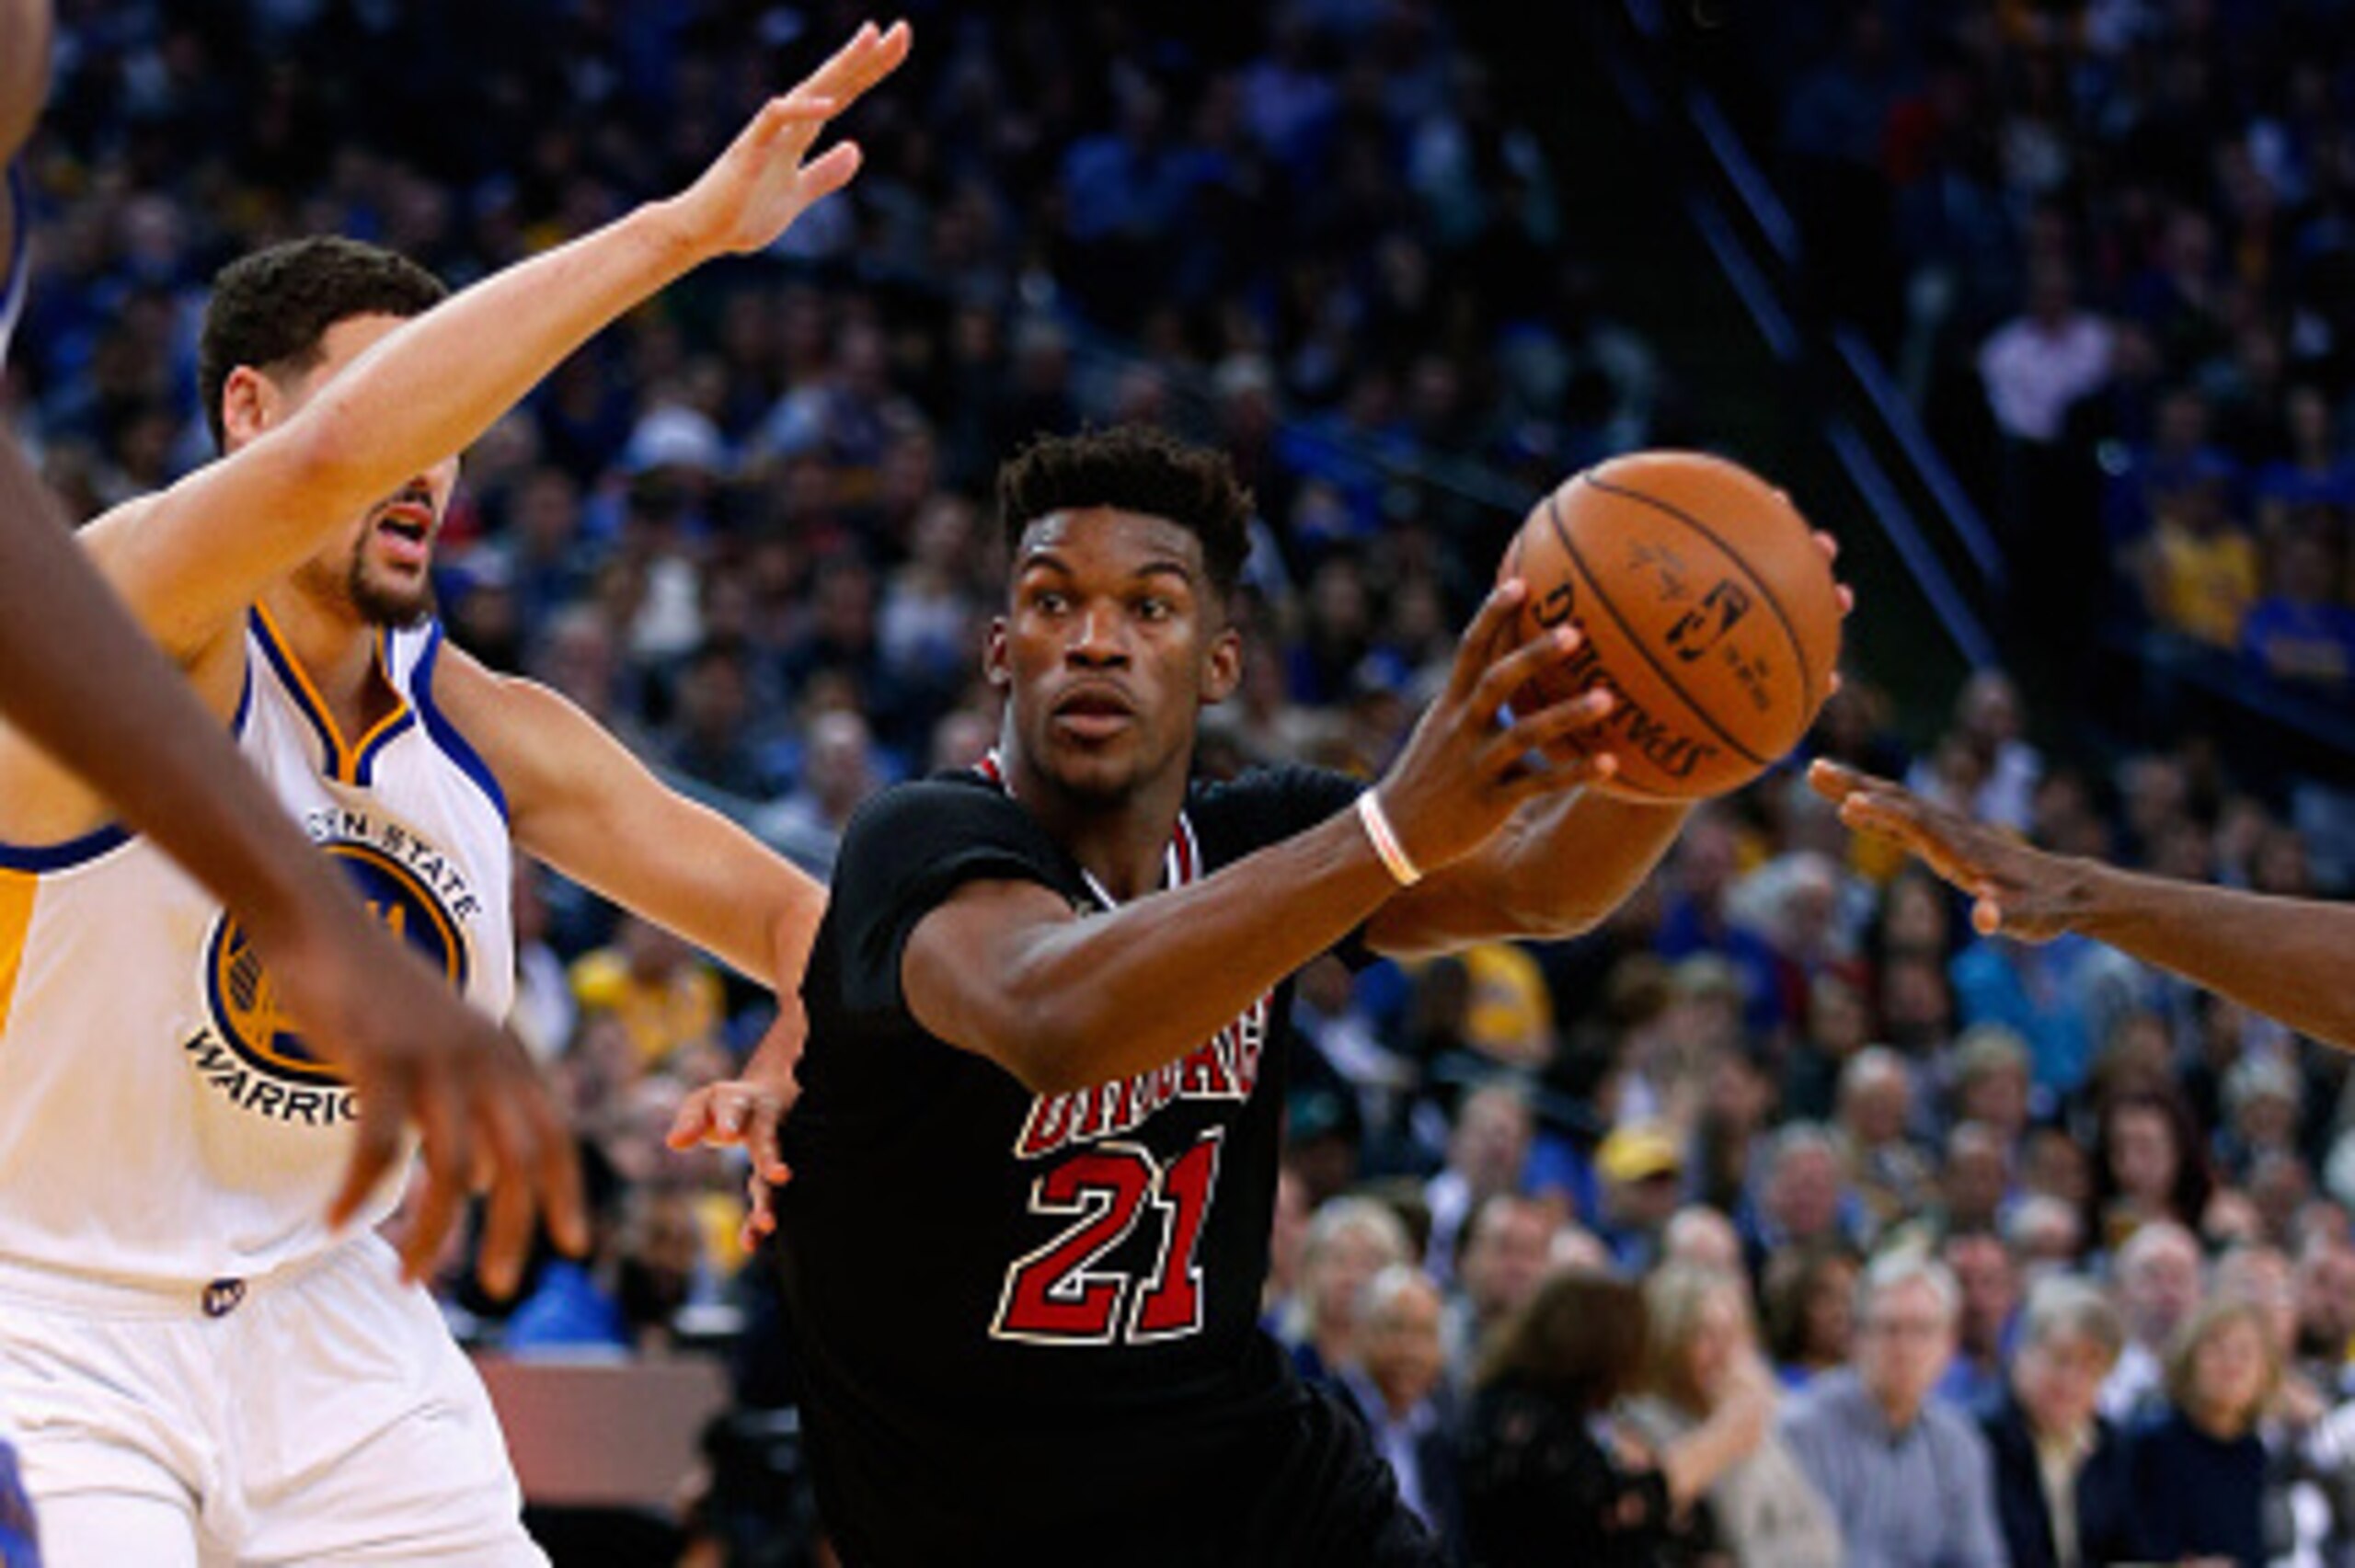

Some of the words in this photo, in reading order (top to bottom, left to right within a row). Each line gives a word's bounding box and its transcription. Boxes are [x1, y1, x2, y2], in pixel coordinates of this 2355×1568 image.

[382, 824, 481, 922] STATE
[185, 1026, 361, 1126] WARRIO
[988, 1124, 1224, 1345] 21
